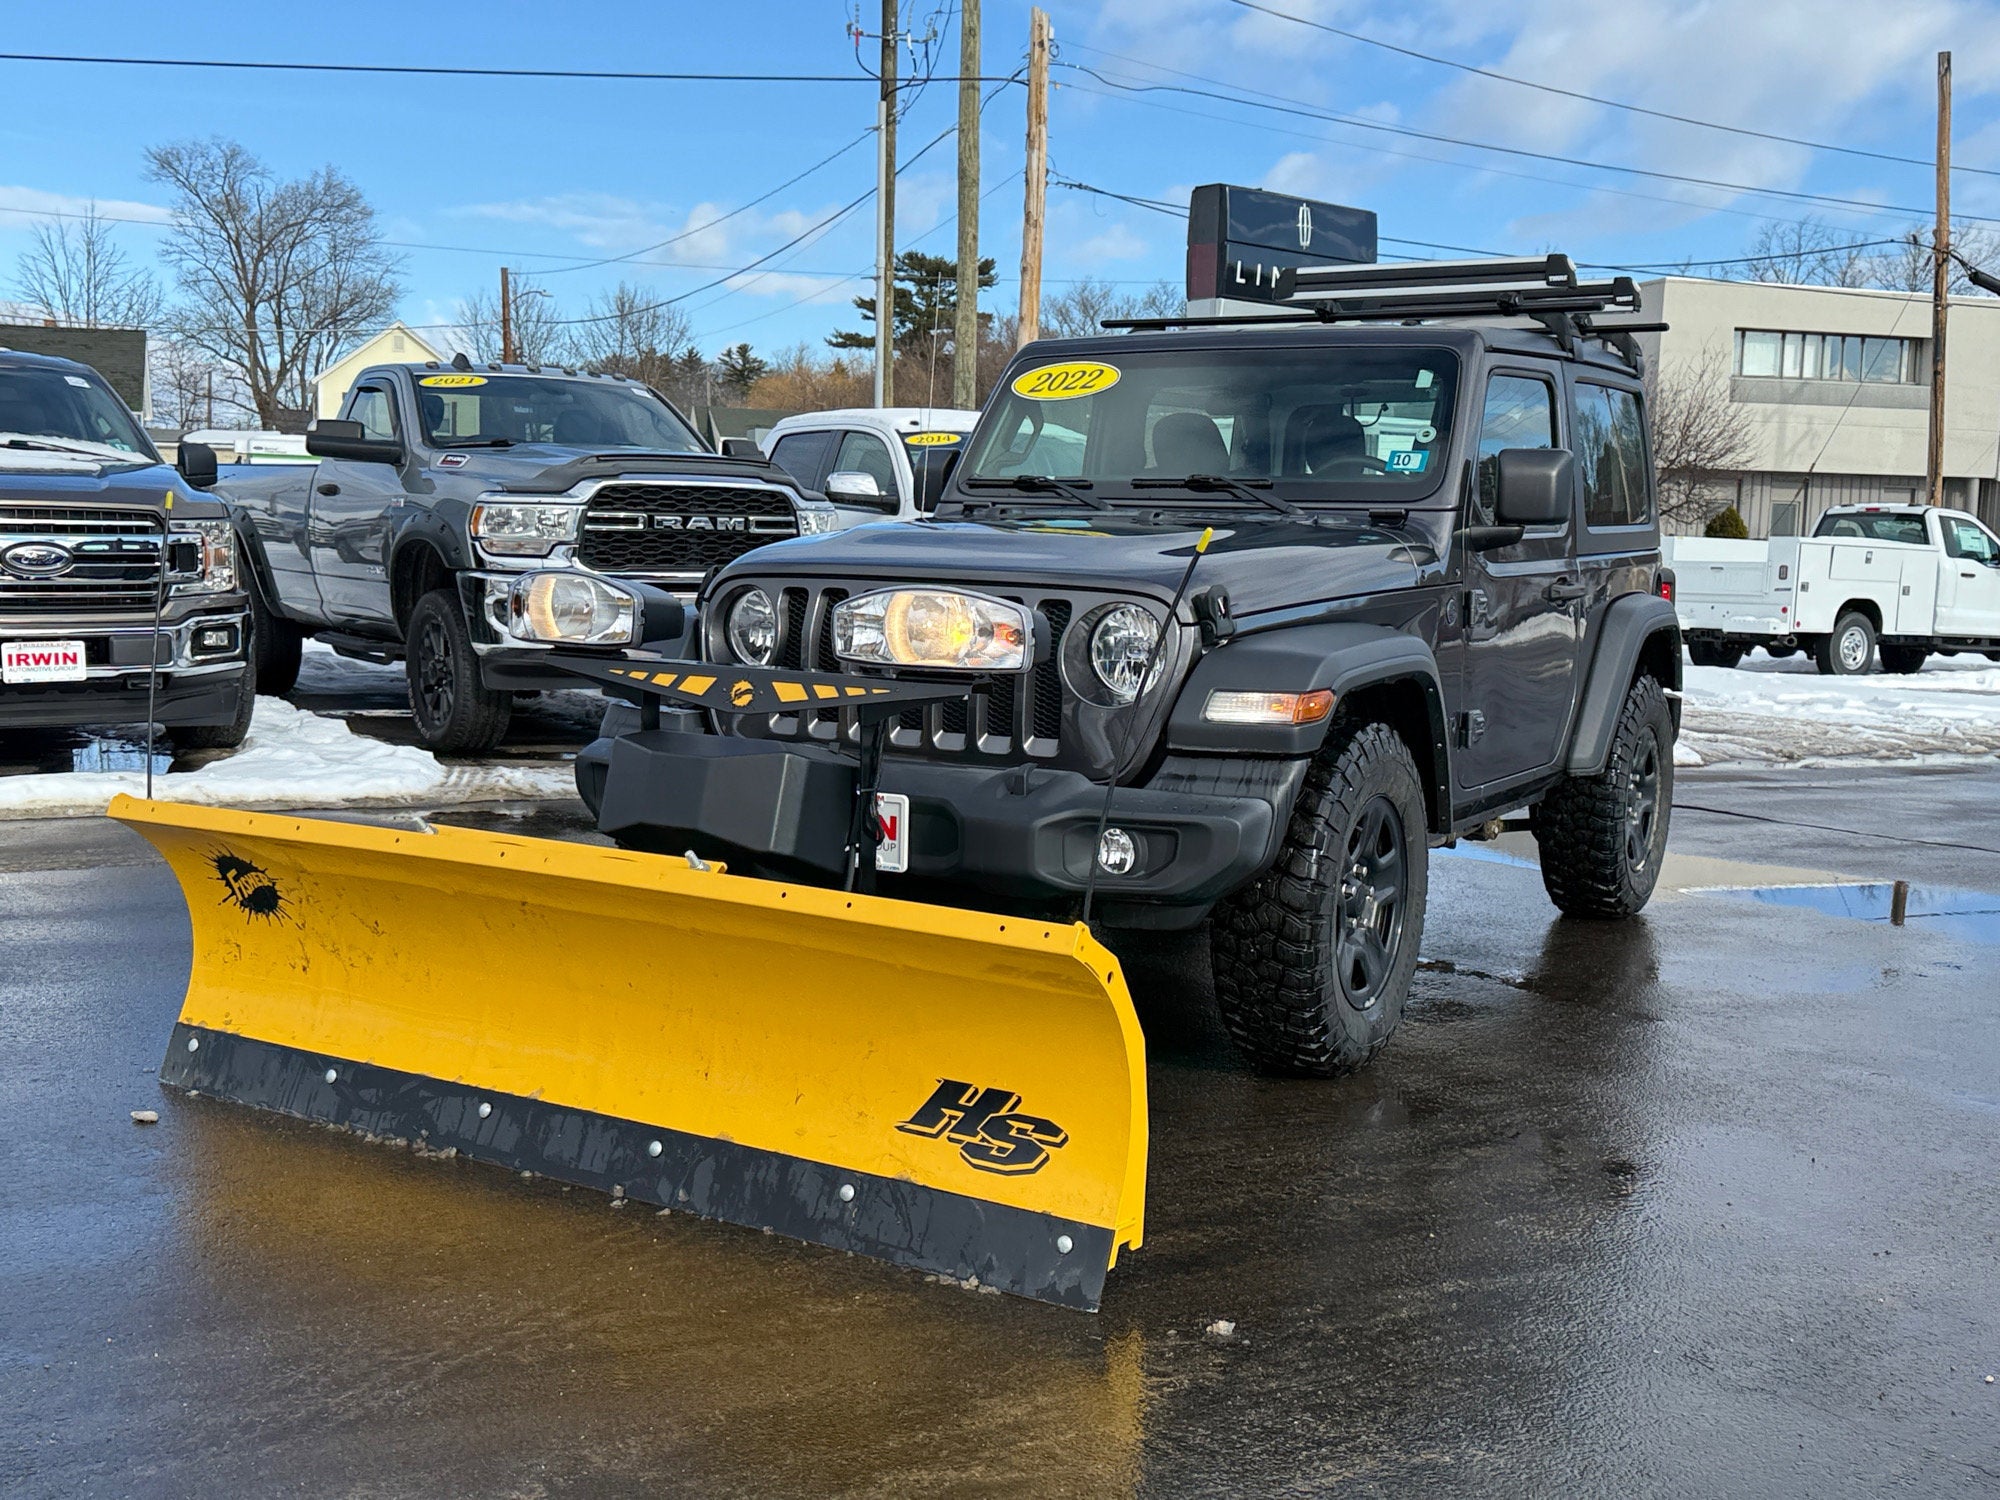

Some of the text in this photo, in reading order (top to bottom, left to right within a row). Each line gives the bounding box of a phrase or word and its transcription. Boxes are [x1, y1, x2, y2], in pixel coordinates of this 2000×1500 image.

[432, 377, 475, 385] 2021
[1027, 368, 1104, 393] 2022
[916, 435, 951, 443] 2014
[1393, 454, 1411, 466] 10
[654, 515, 745, 531] RAM
[19, 549, 58, 565] Ford
[7, 651, 78, 667] IRWIN
[894, 1077, 1070, 1176] HS
